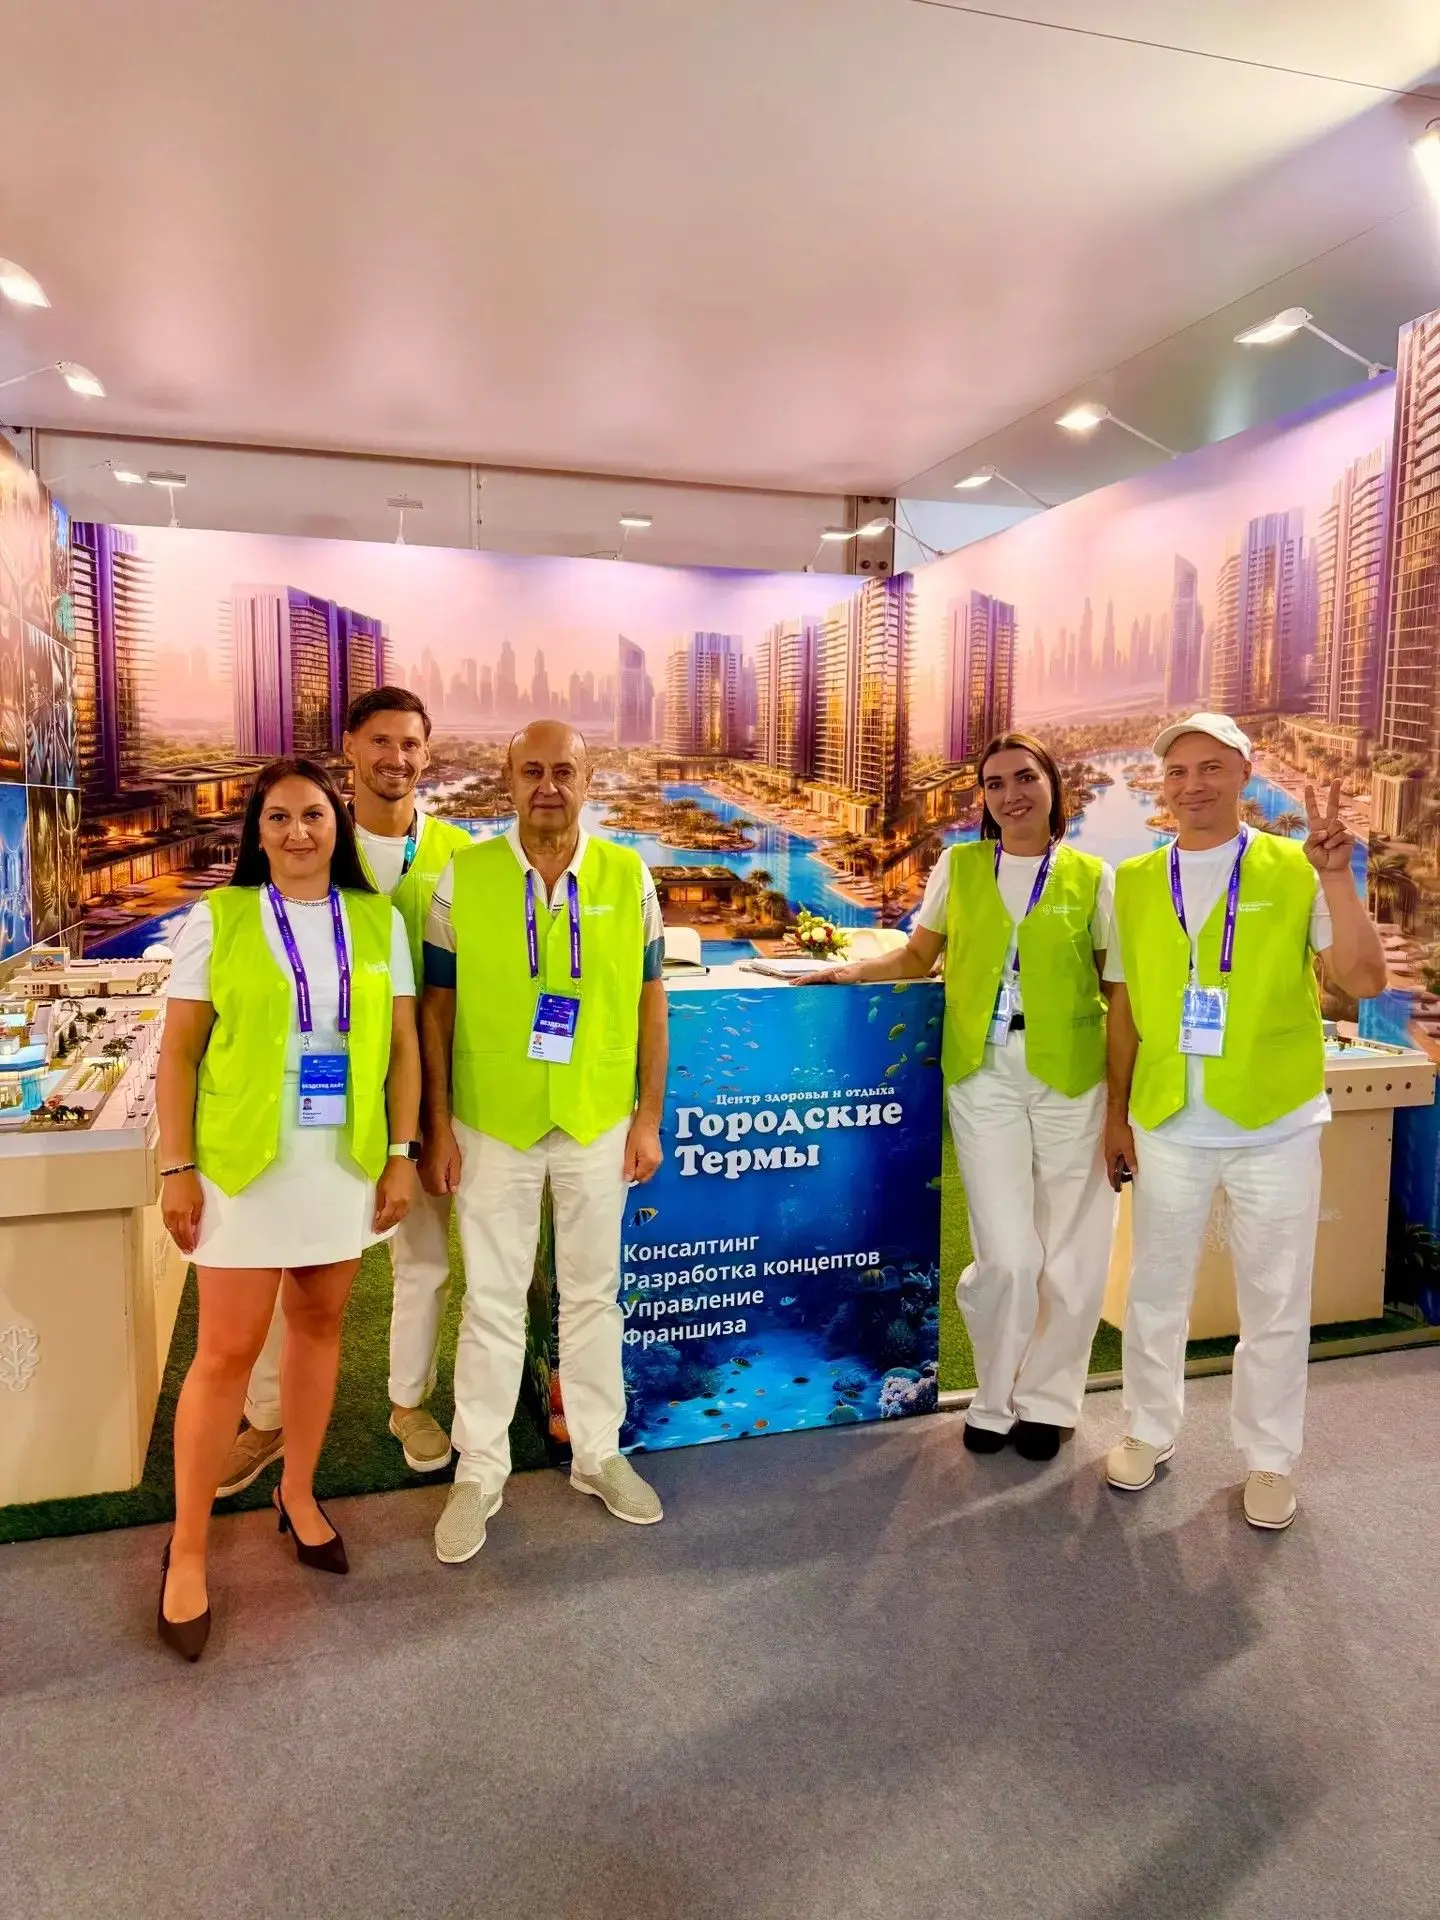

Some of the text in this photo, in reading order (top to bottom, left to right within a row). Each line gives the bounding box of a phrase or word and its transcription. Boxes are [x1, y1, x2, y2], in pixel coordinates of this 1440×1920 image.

[716, 1093, 760, 1106] Центр
[764, 1090, 828, 1103] здоровья
[845, 1086, 895, 1098] отдыха
[674, 1102, 903, 1142] Городские
[674, 1144, 819, 1179] Термы
[623, 1235, 760, 1263] Консалтинг
[623, 1251, 880, 1291] Разработка концептов
[623, 1288, 764, 1320] Управление
[622, 1318, 747, 1350] Франшиза
